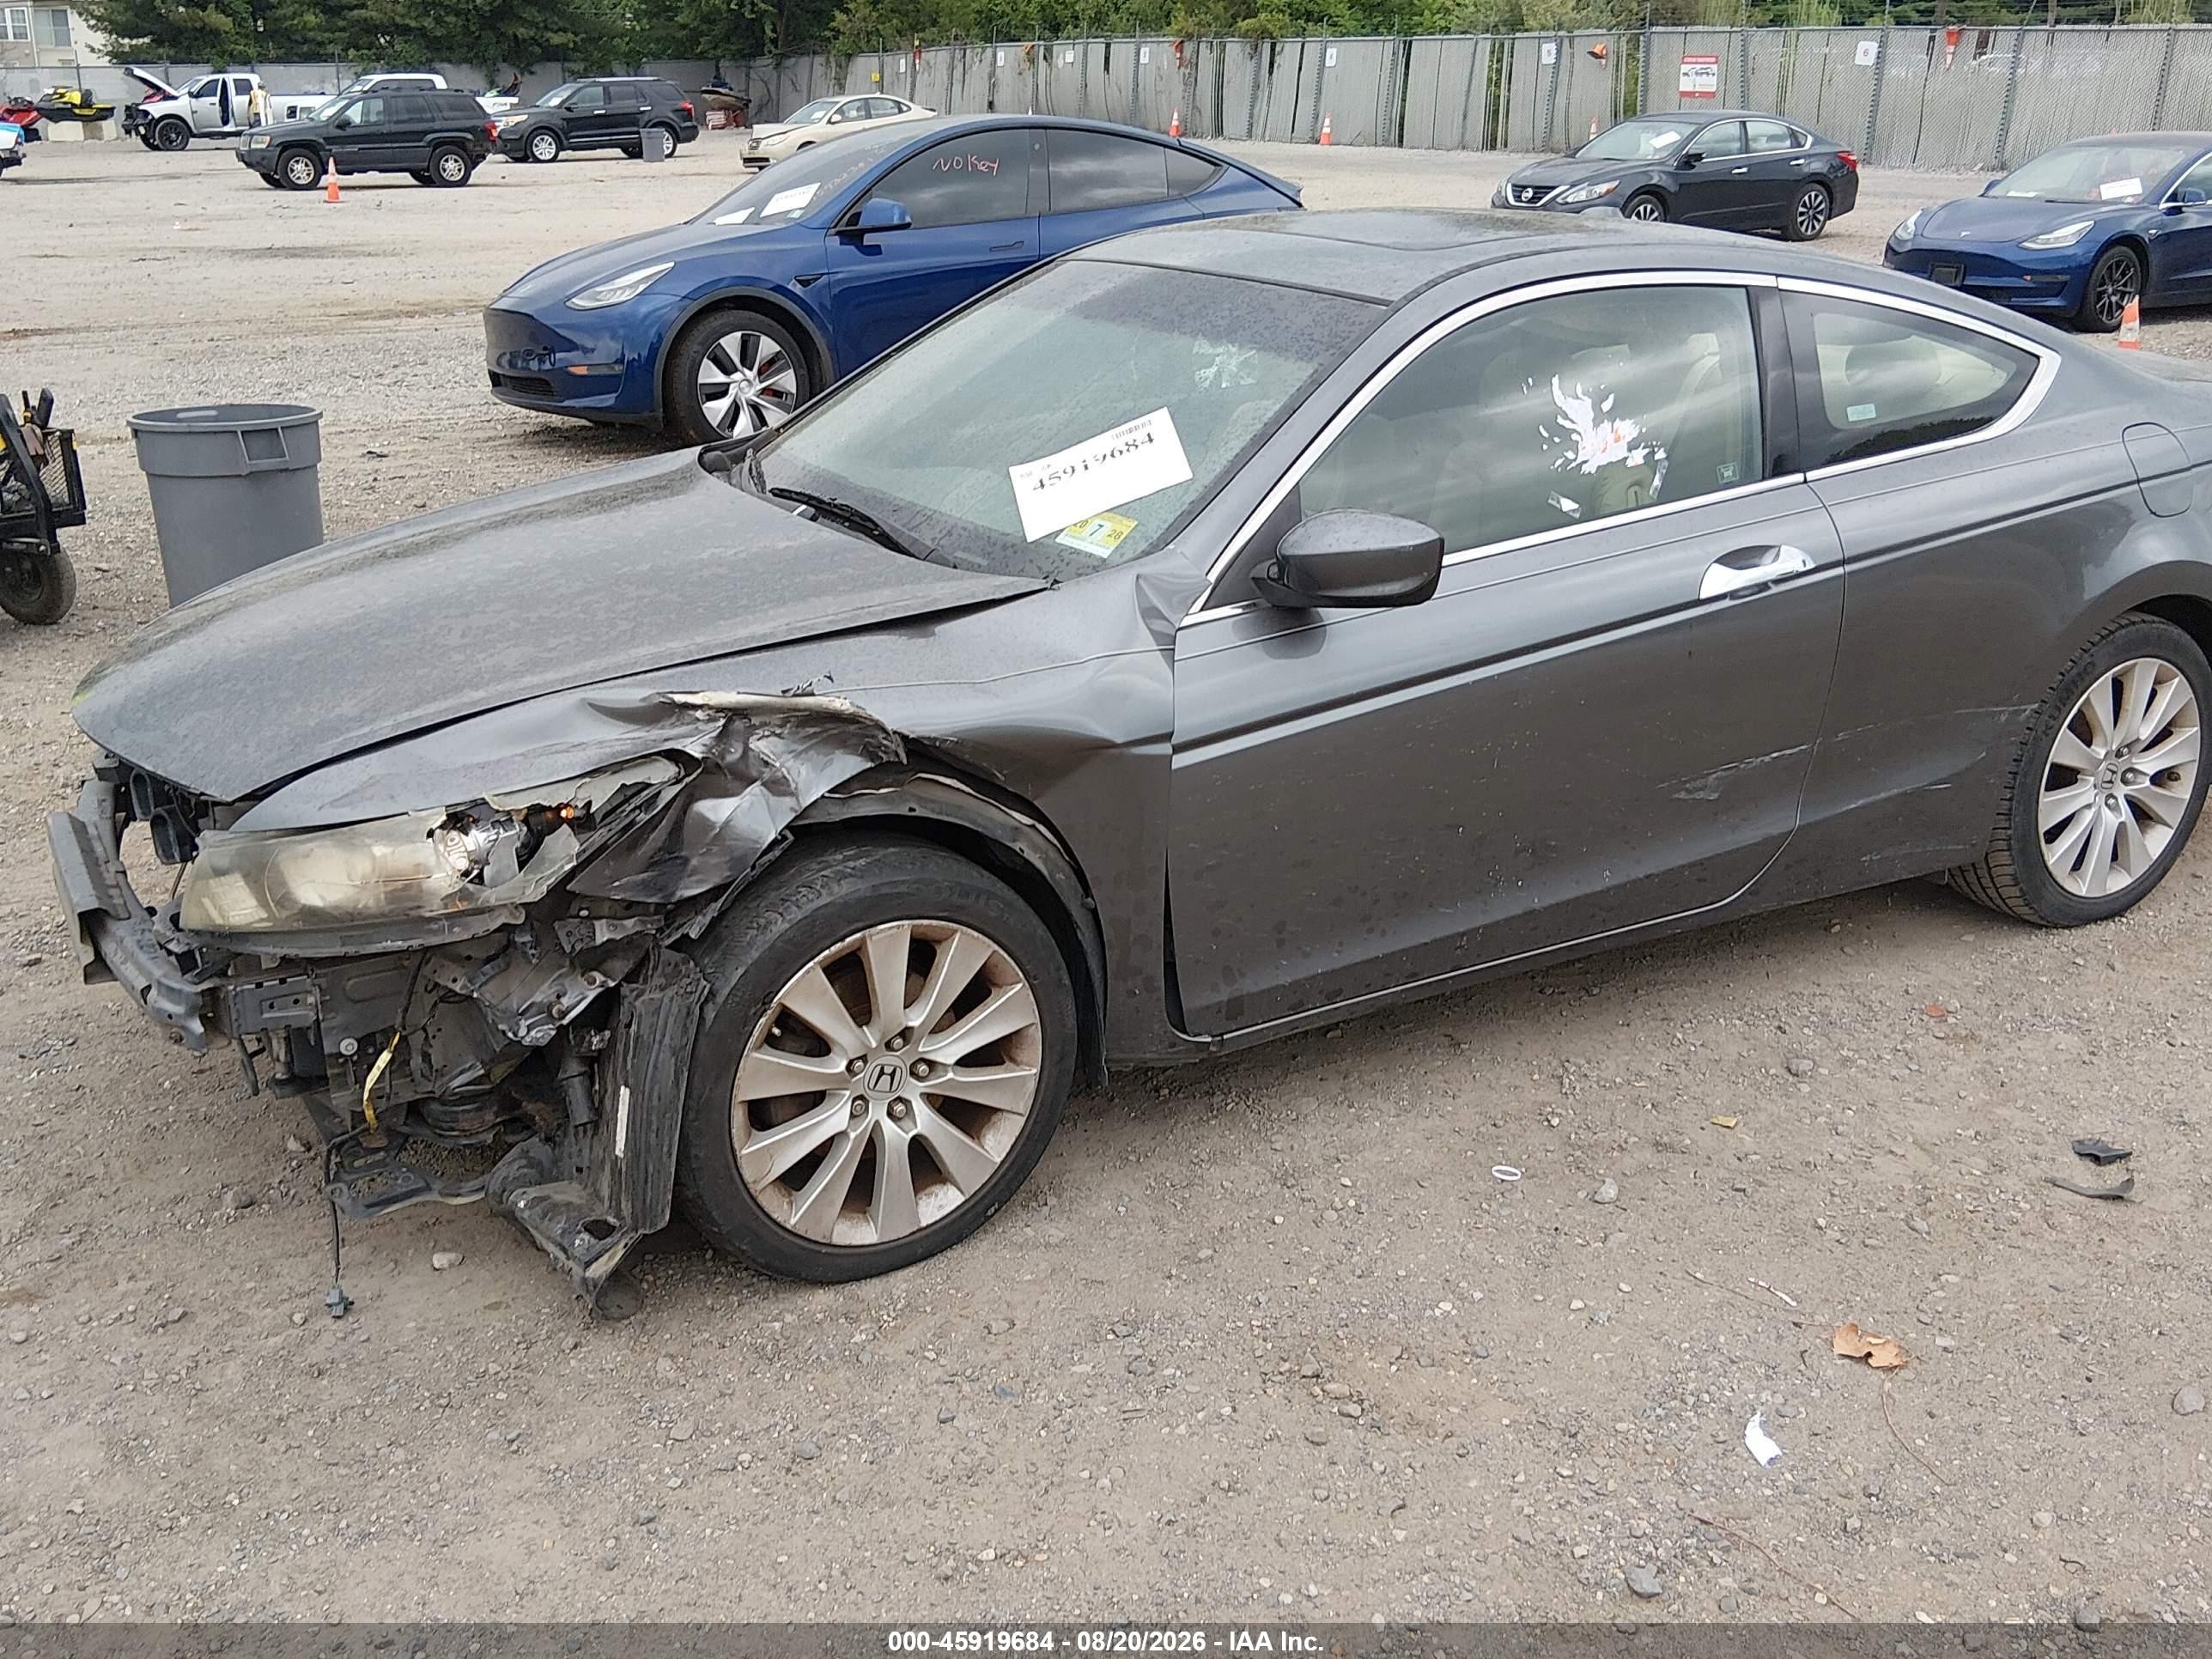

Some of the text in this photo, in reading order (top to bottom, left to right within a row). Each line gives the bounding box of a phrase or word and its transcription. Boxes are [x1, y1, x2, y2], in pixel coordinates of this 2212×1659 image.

[1032, 431, 1155, 492] 45919684
[1087, 522, 1105, 538] 7
[1105, 528, 1124, 540] 28
